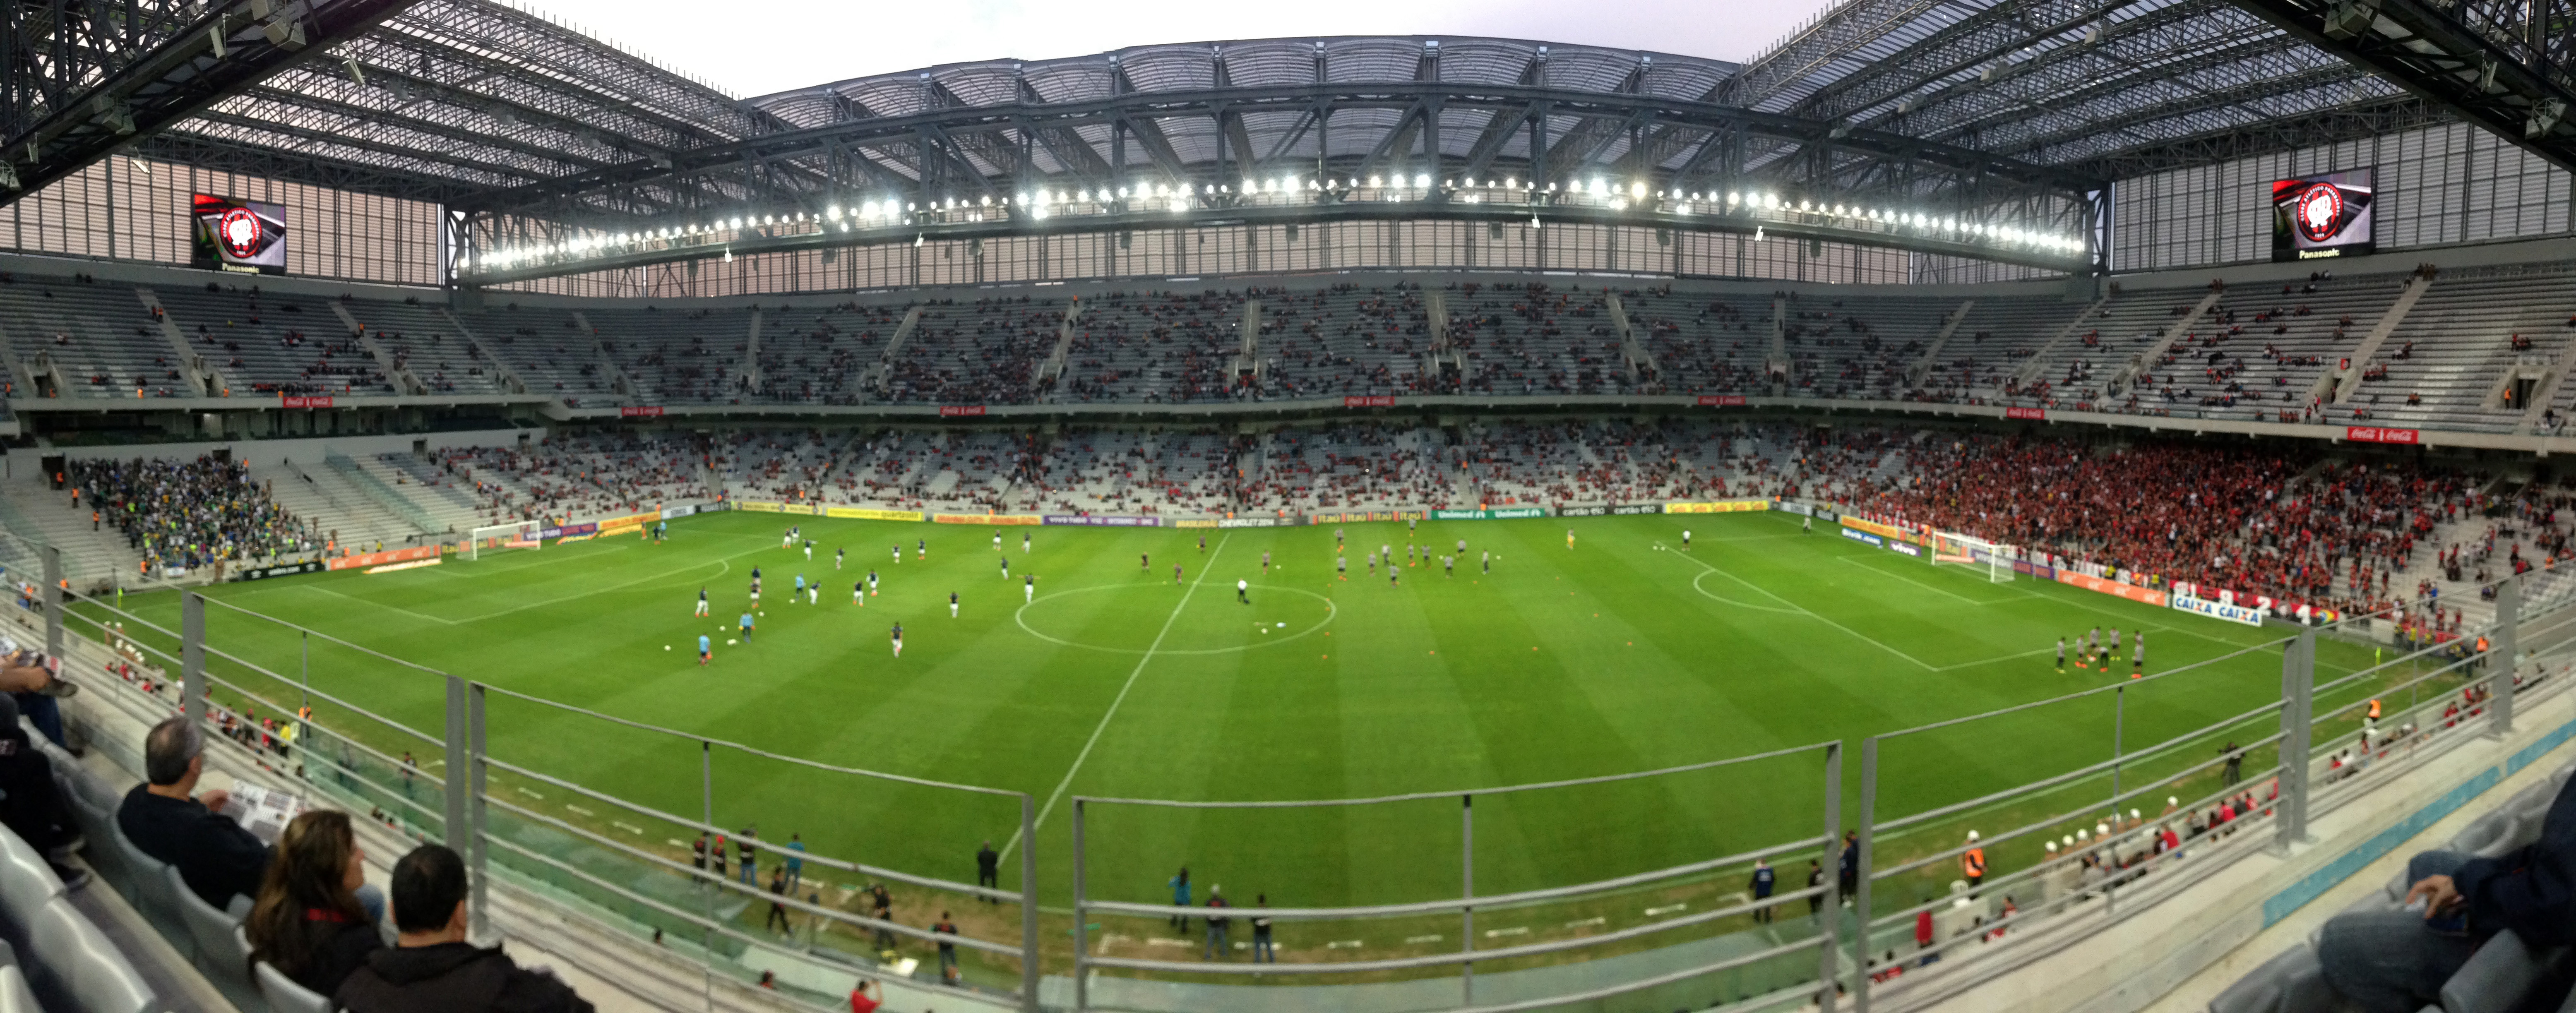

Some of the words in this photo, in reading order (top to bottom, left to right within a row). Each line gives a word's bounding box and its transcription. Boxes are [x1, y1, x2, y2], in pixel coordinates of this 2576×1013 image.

[2299, 248, 2340, 259] Panasonic
[222, 262, 260, 274] Panasonic
[1590, 506, 1605, 515] elo
[1614, 506, 1640, 515] cartão
[1641, 505, 1656, 514] elo
[1218, 519, 1257, 528] CHEVROLET
[1891, 543, 1917, 556] vivo
[268, 566, 300, 576] umbro.com
[2176, 597, 2212, 614] CAIXA
[2219, 606, 2259, 624] CAIXA
[2258, 595, 2272, 617] 2
[2296, 604, 2310, 626] 4
